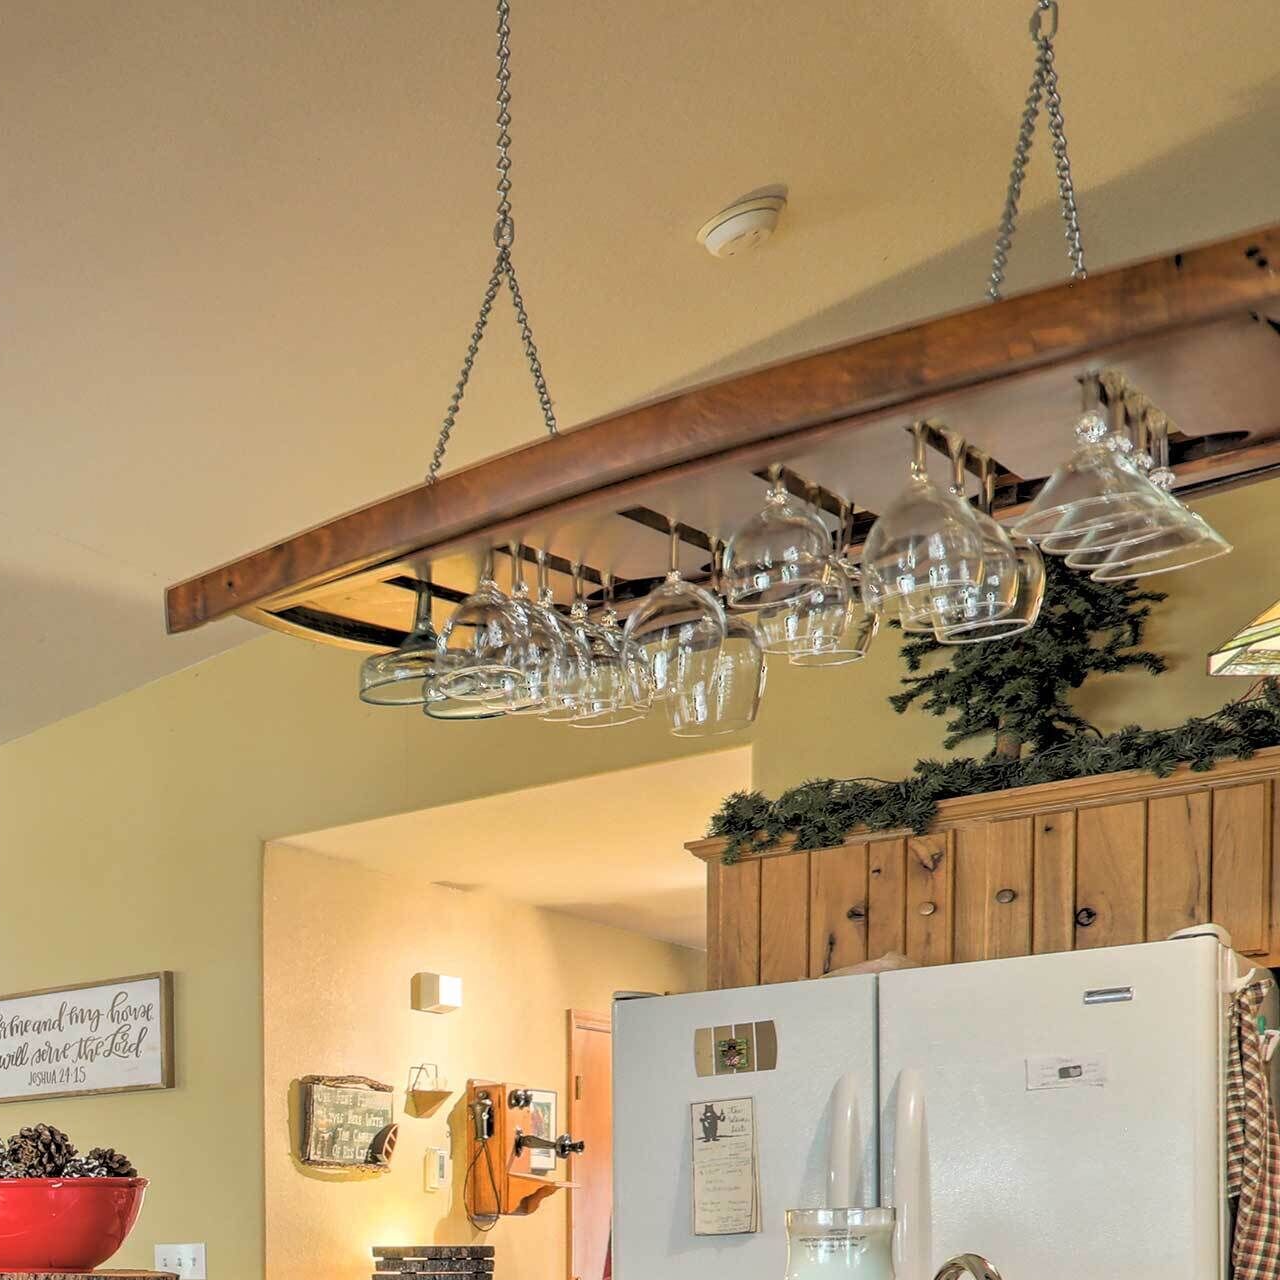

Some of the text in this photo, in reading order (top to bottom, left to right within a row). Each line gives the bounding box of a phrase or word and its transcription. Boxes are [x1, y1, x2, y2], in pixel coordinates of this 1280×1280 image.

[8, 1015, 32, 1036] me
[32, 1001, 65, 1034] and
[66, 1006, 104, 1033] my
[107, 991, 154, 1024] house
[31, 1041, 72, 1066] serve
[71, 1036, 104, 1063] the
[28, 1070, 57, 1087] JOSHUA
